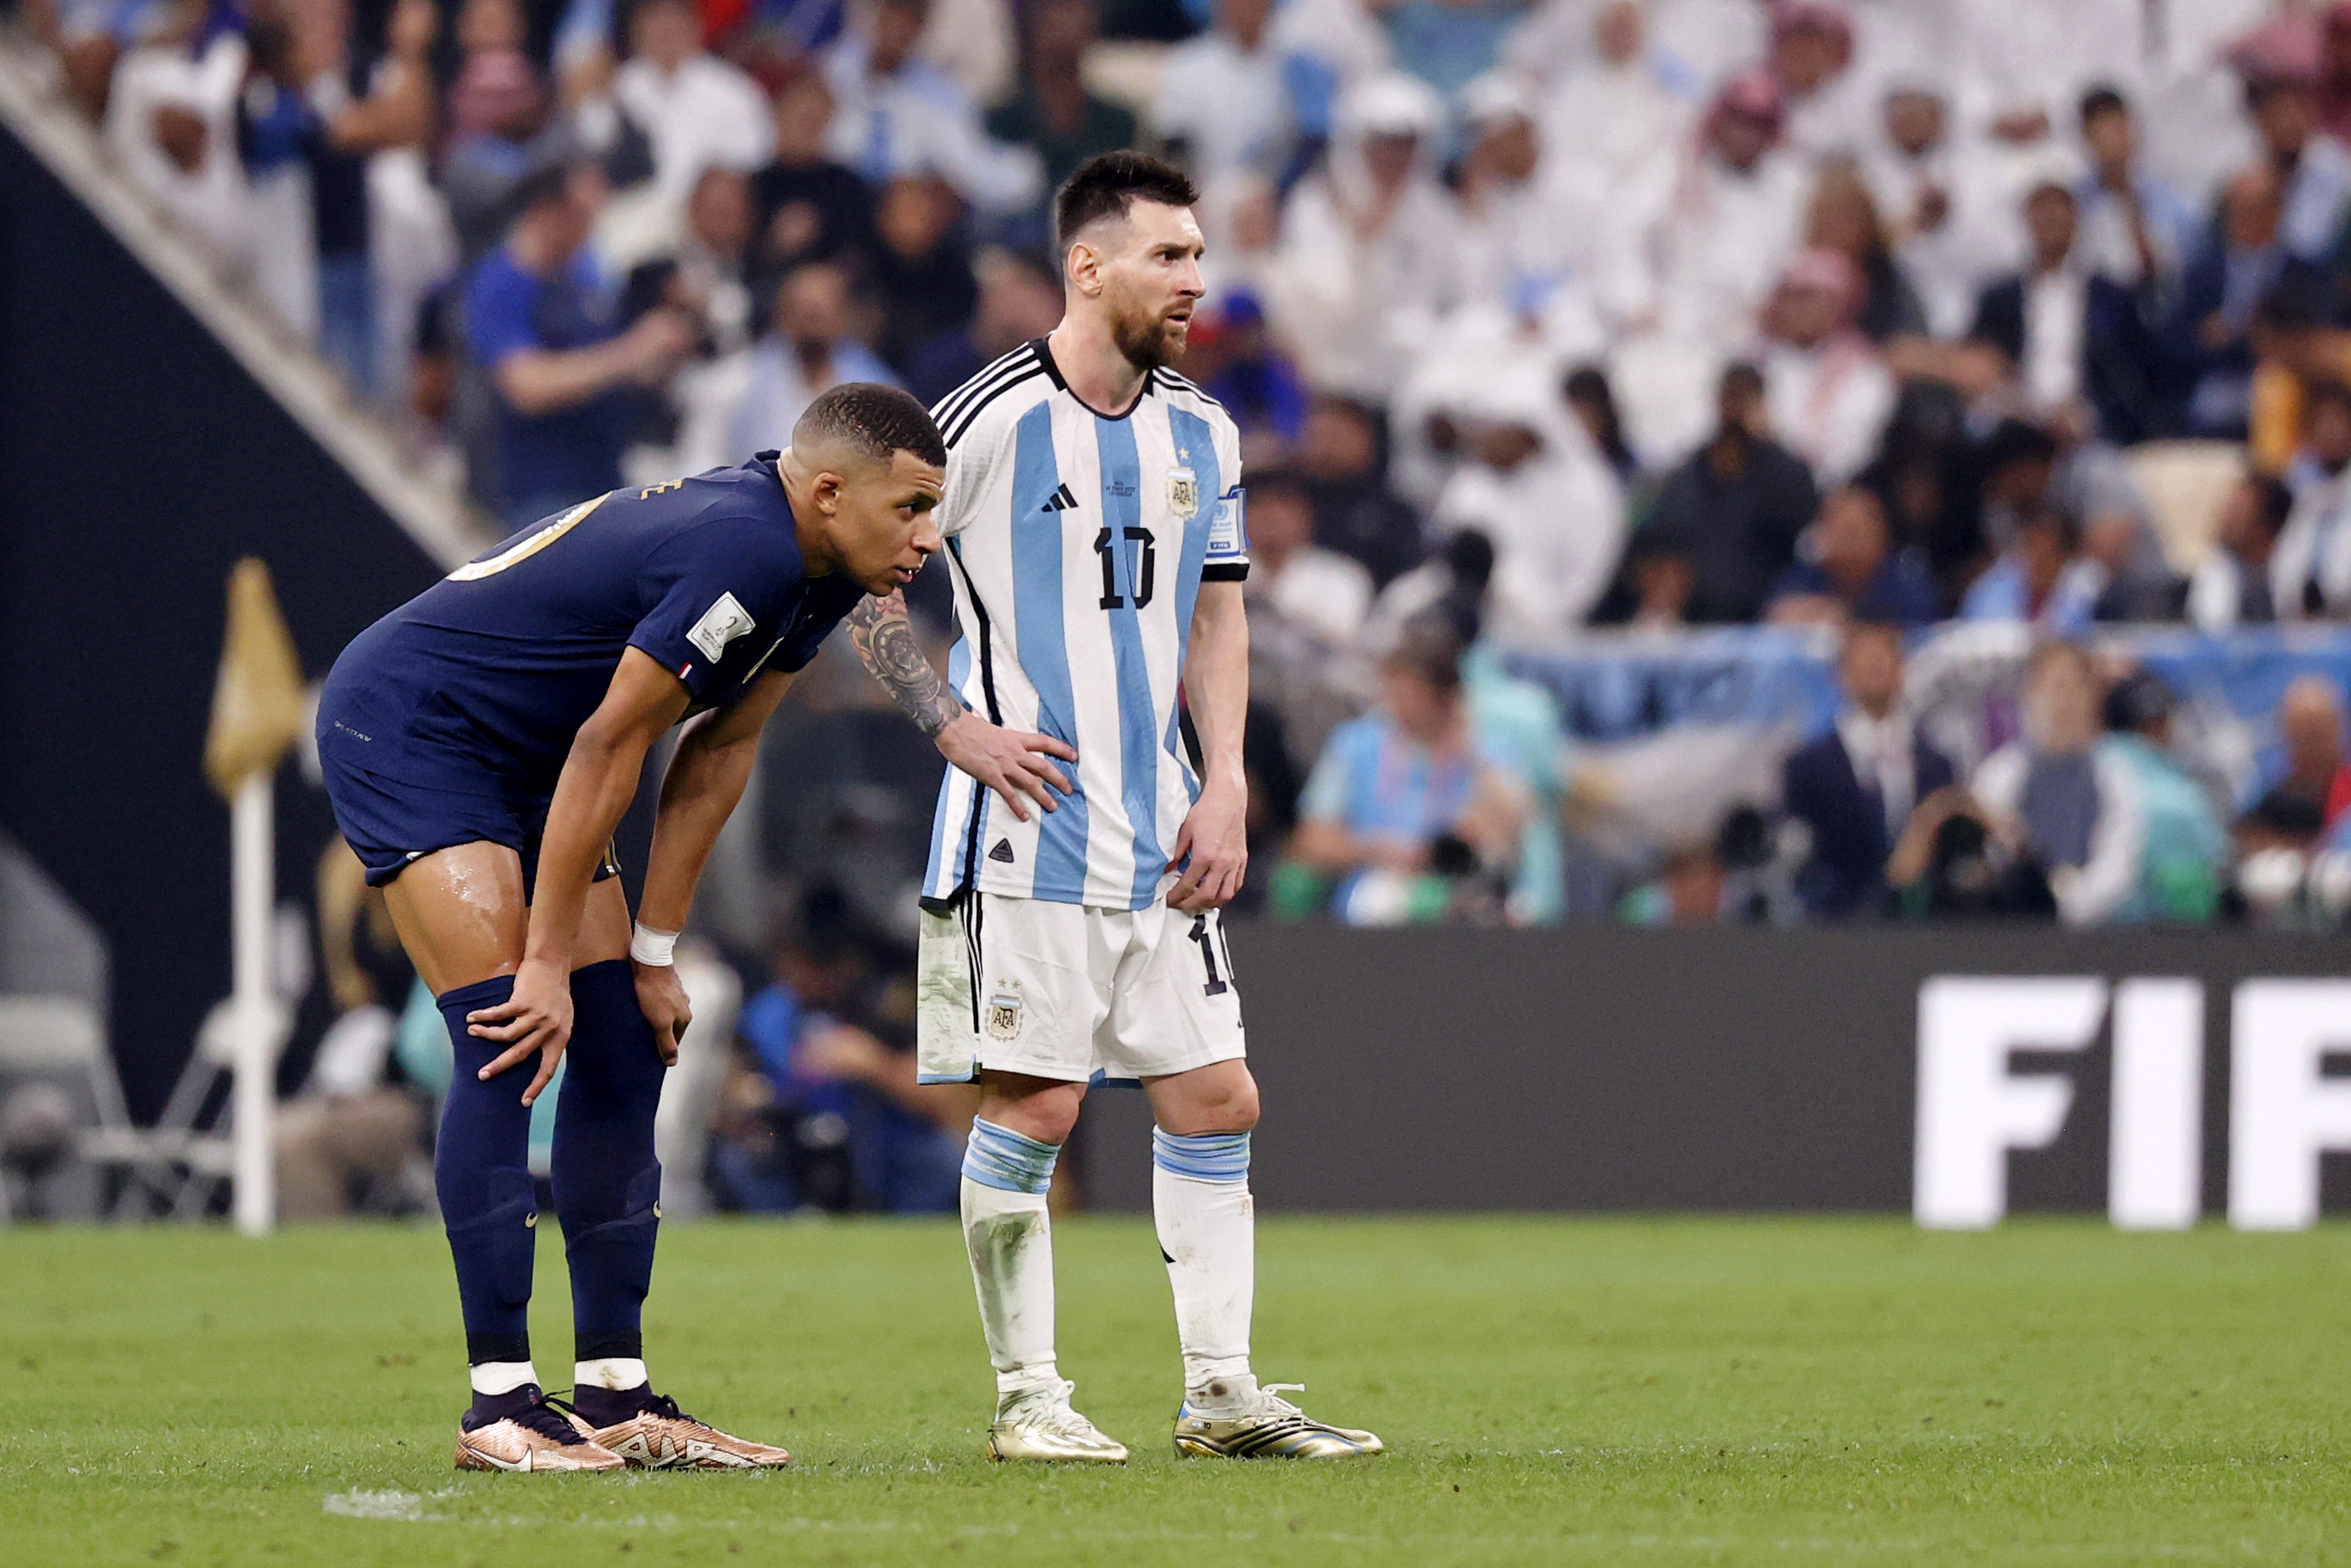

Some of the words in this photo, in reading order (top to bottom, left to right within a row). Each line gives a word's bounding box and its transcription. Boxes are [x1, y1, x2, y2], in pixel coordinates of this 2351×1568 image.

[1173, 480, 1191, 505] AFA
[1093, 526, 1155, 610] 10
[1187, 914, 1233, 997] 1
[993, 1006, 1014, 1029] AFA
